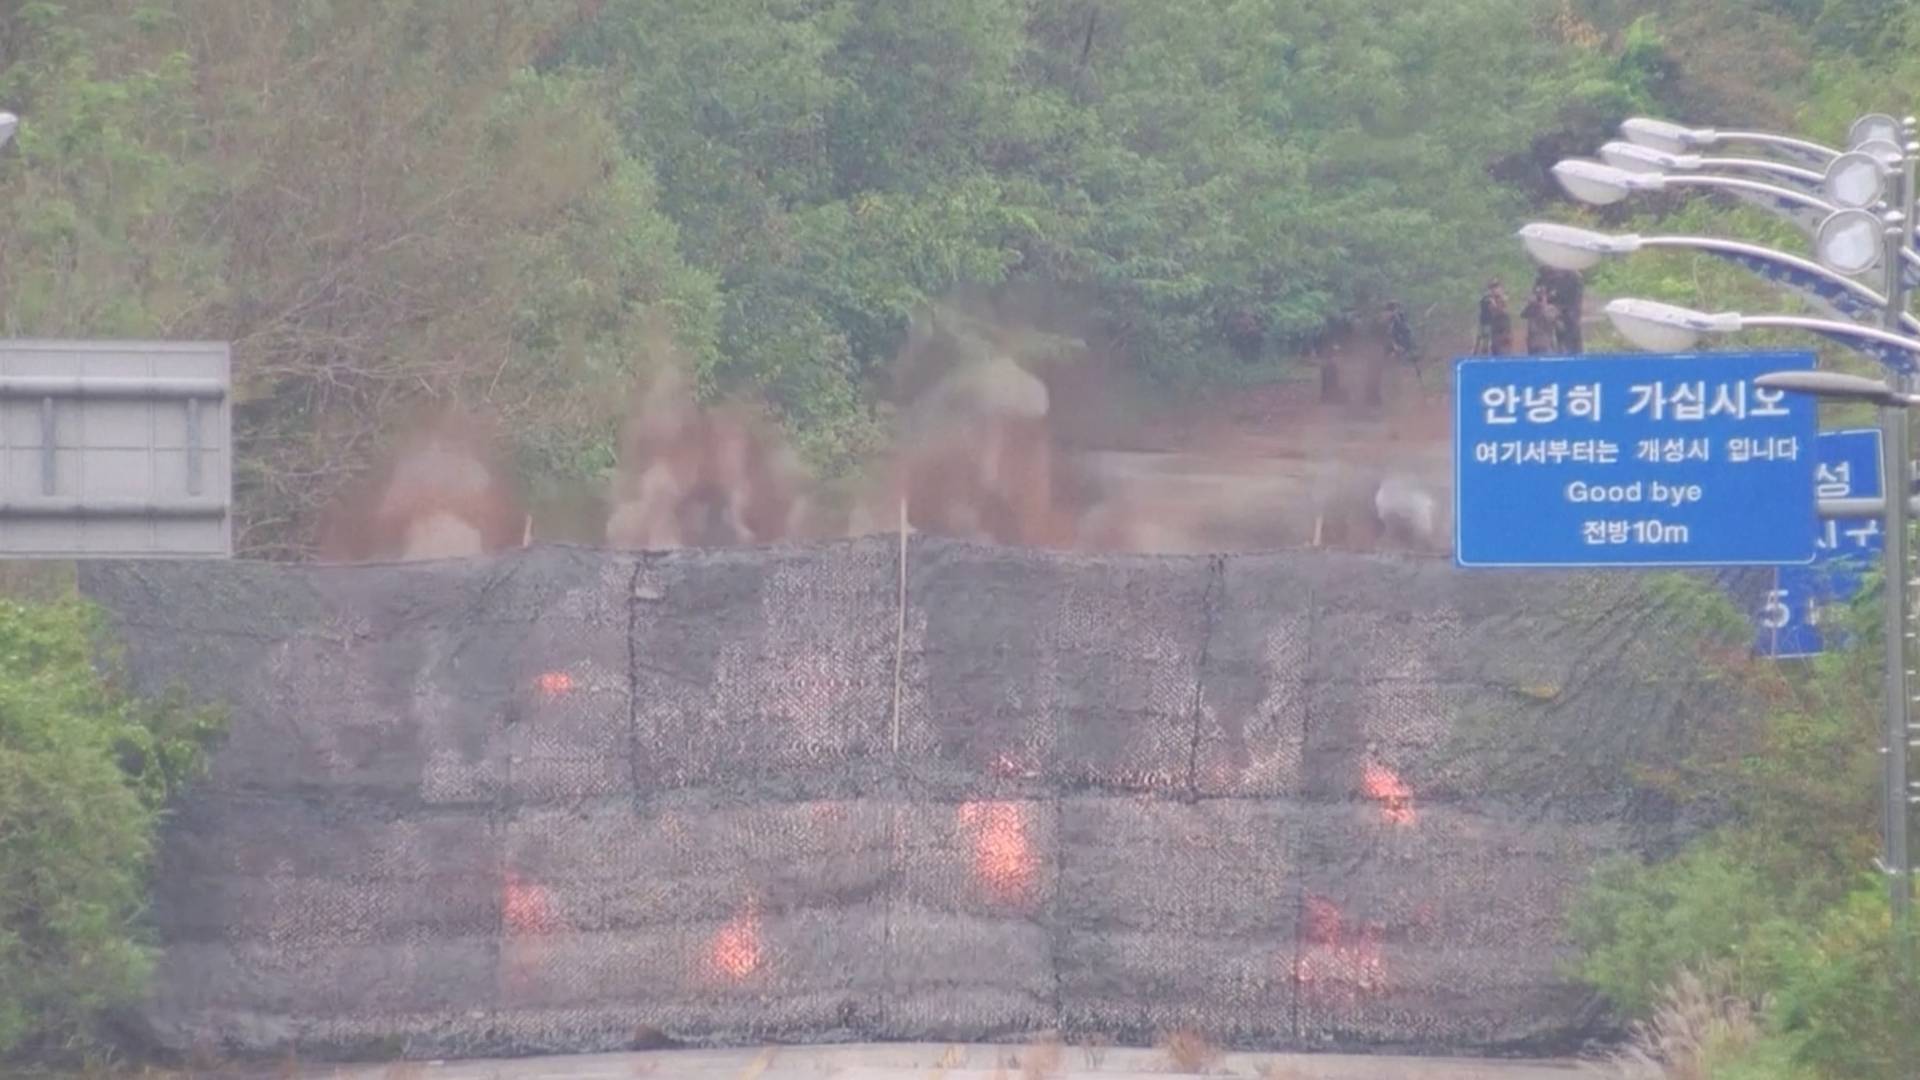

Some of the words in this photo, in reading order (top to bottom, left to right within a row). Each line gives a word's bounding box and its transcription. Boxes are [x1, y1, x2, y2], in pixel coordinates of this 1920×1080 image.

[1481, 383, 1602, 424] 안녕히
[1627, 380, 1790, 421] 가십시오
[1475, 440, 1619, 464] 여기서부터는
[1637, 438, 1710, 462] 개성시
[1728, 437, 1799, 462] 입니다
[1567, 481, 1642, 502] Good
[1651, 481, 1702, 506] bye
[1583, 520, 1689, 544] 전방10m
